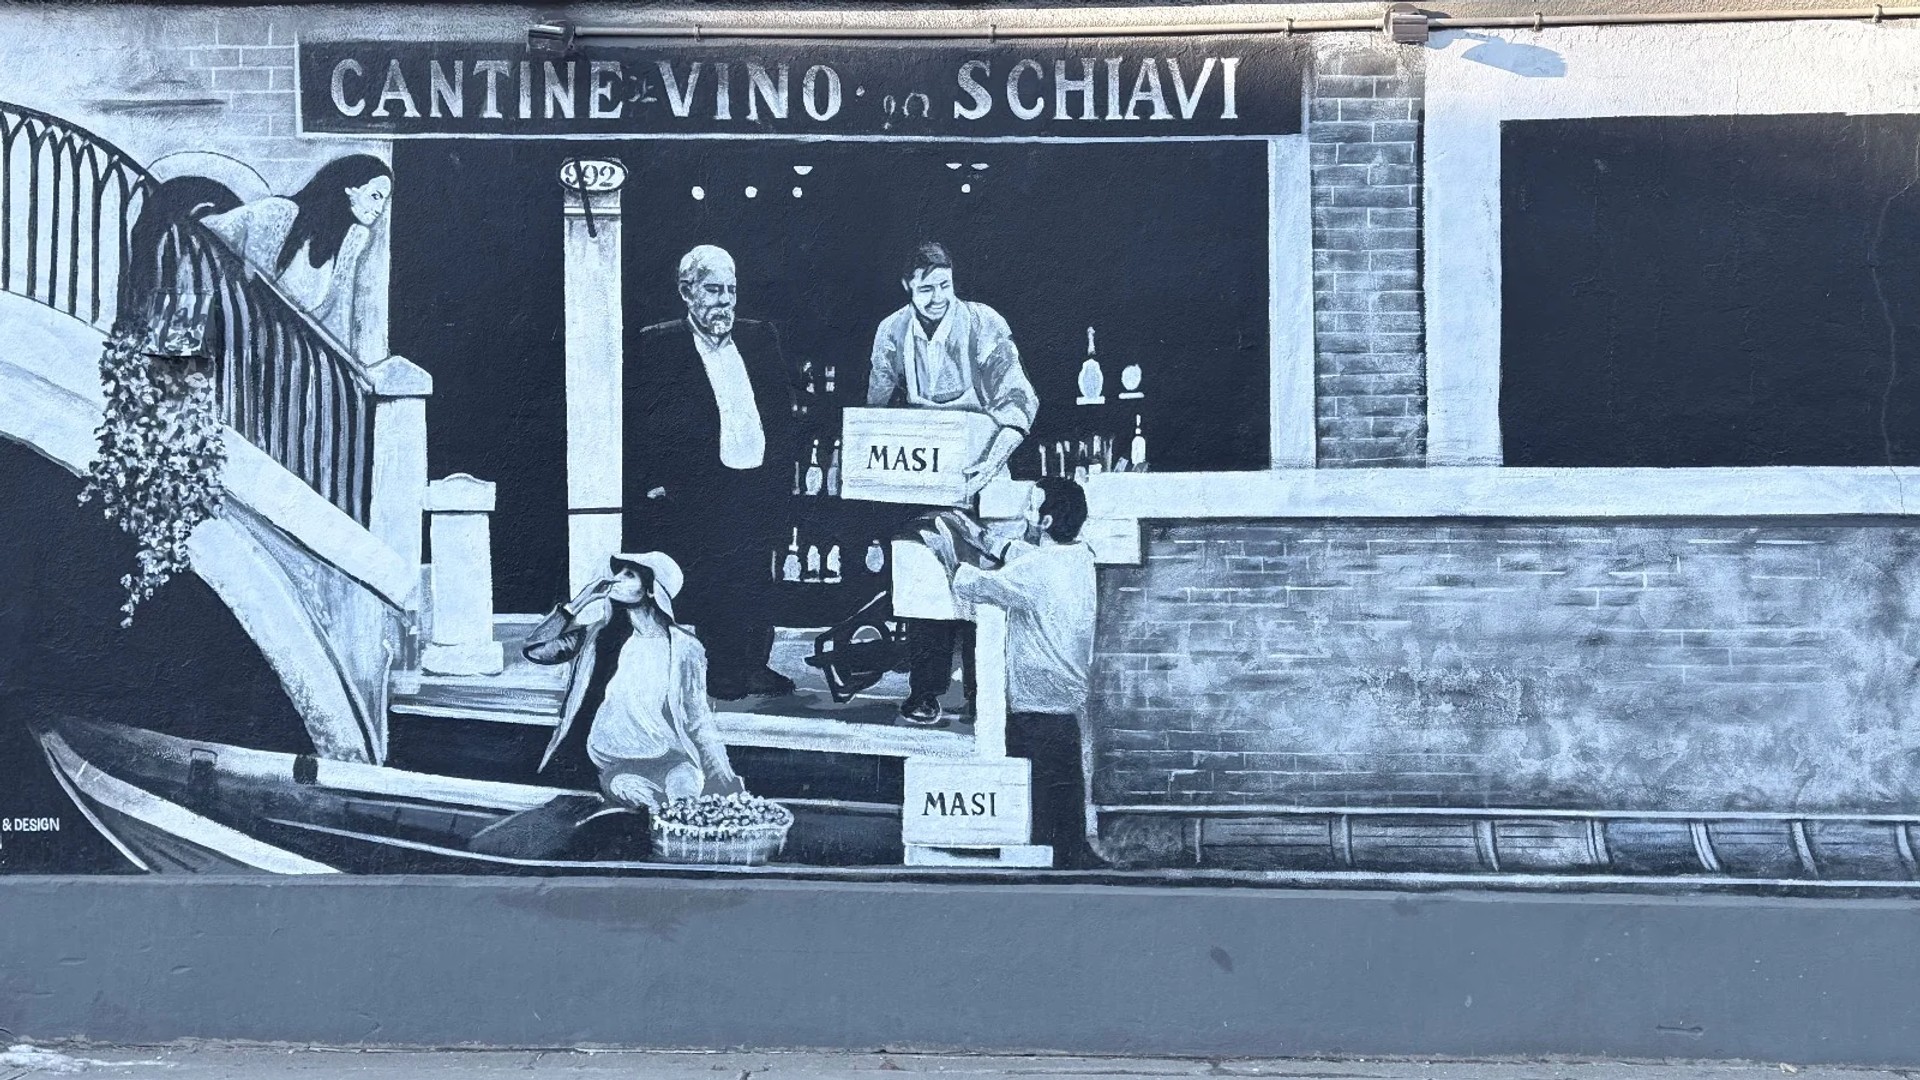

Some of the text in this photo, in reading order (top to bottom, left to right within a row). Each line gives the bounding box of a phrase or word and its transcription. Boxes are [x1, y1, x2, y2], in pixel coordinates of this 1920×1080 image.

[330, 58, 624, 119] CANTINE
[656, 60, 842, 122] VINO
[953, 57, 1240, 120] SCHIAVI
[866, 445, 940, 473] MASI
[921, 791, 997, 817] MASI
[2, 817, 60, 832] & DESIGN
